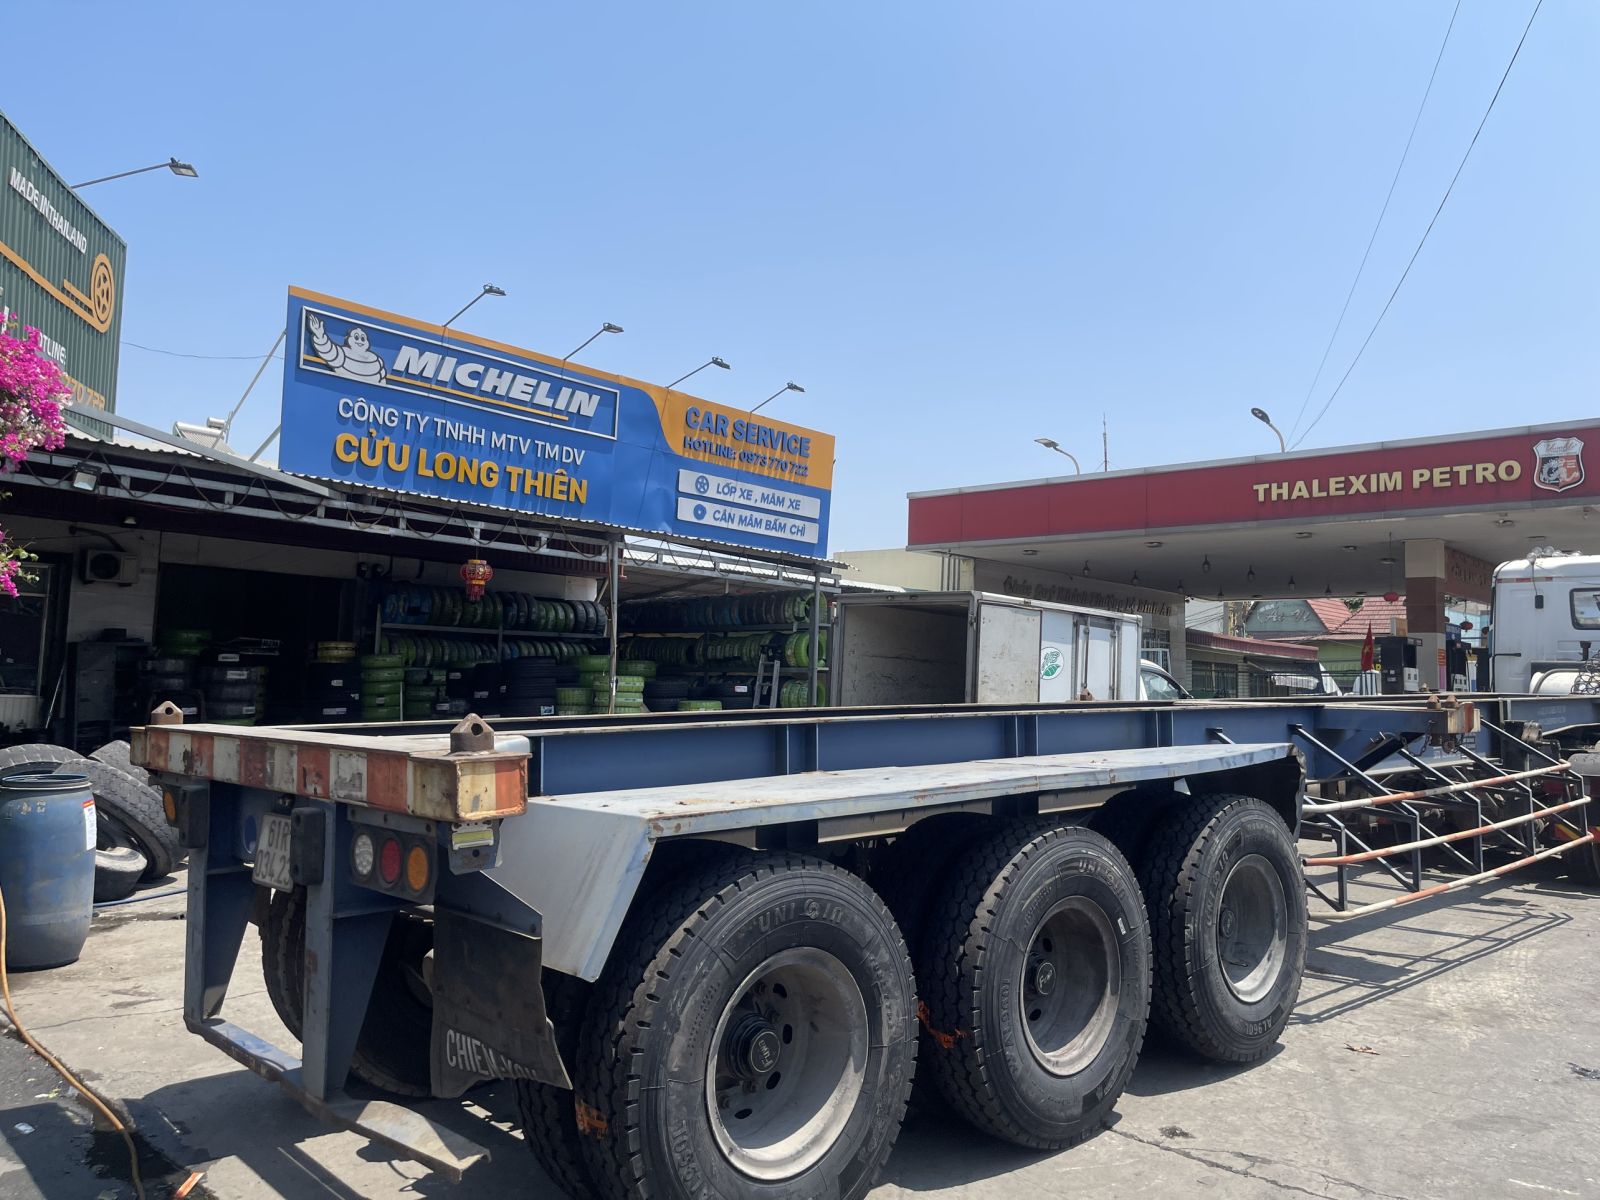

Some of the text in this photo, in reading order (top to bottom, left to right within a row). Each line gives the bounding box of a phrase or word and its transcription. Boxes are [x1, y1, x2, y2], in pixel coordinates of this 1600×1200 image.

[10, 167, 87, 254] MADE IN THAILAND
[392, 345, 601, 418] MICHELIN
[338, 397, 399, 427] CÔNG
[403, 411, 430, 433] TY
[434, 417, 486, 446] TNHH
[491, 431, 532, 455] MTV
[684, 435, 736, 460] HOTLINE:
[686, 406, 812, 458] CAR SERVICE
[335, 428, 588, 504] CỬU LONG THIÊN
[1253, 459, 1521, 503] THALEXIM PETRO
[713, 508, 735, 525] CÂN
[738, 514, 763, 529] MÂM
[788, 498, 801, 510] XE
